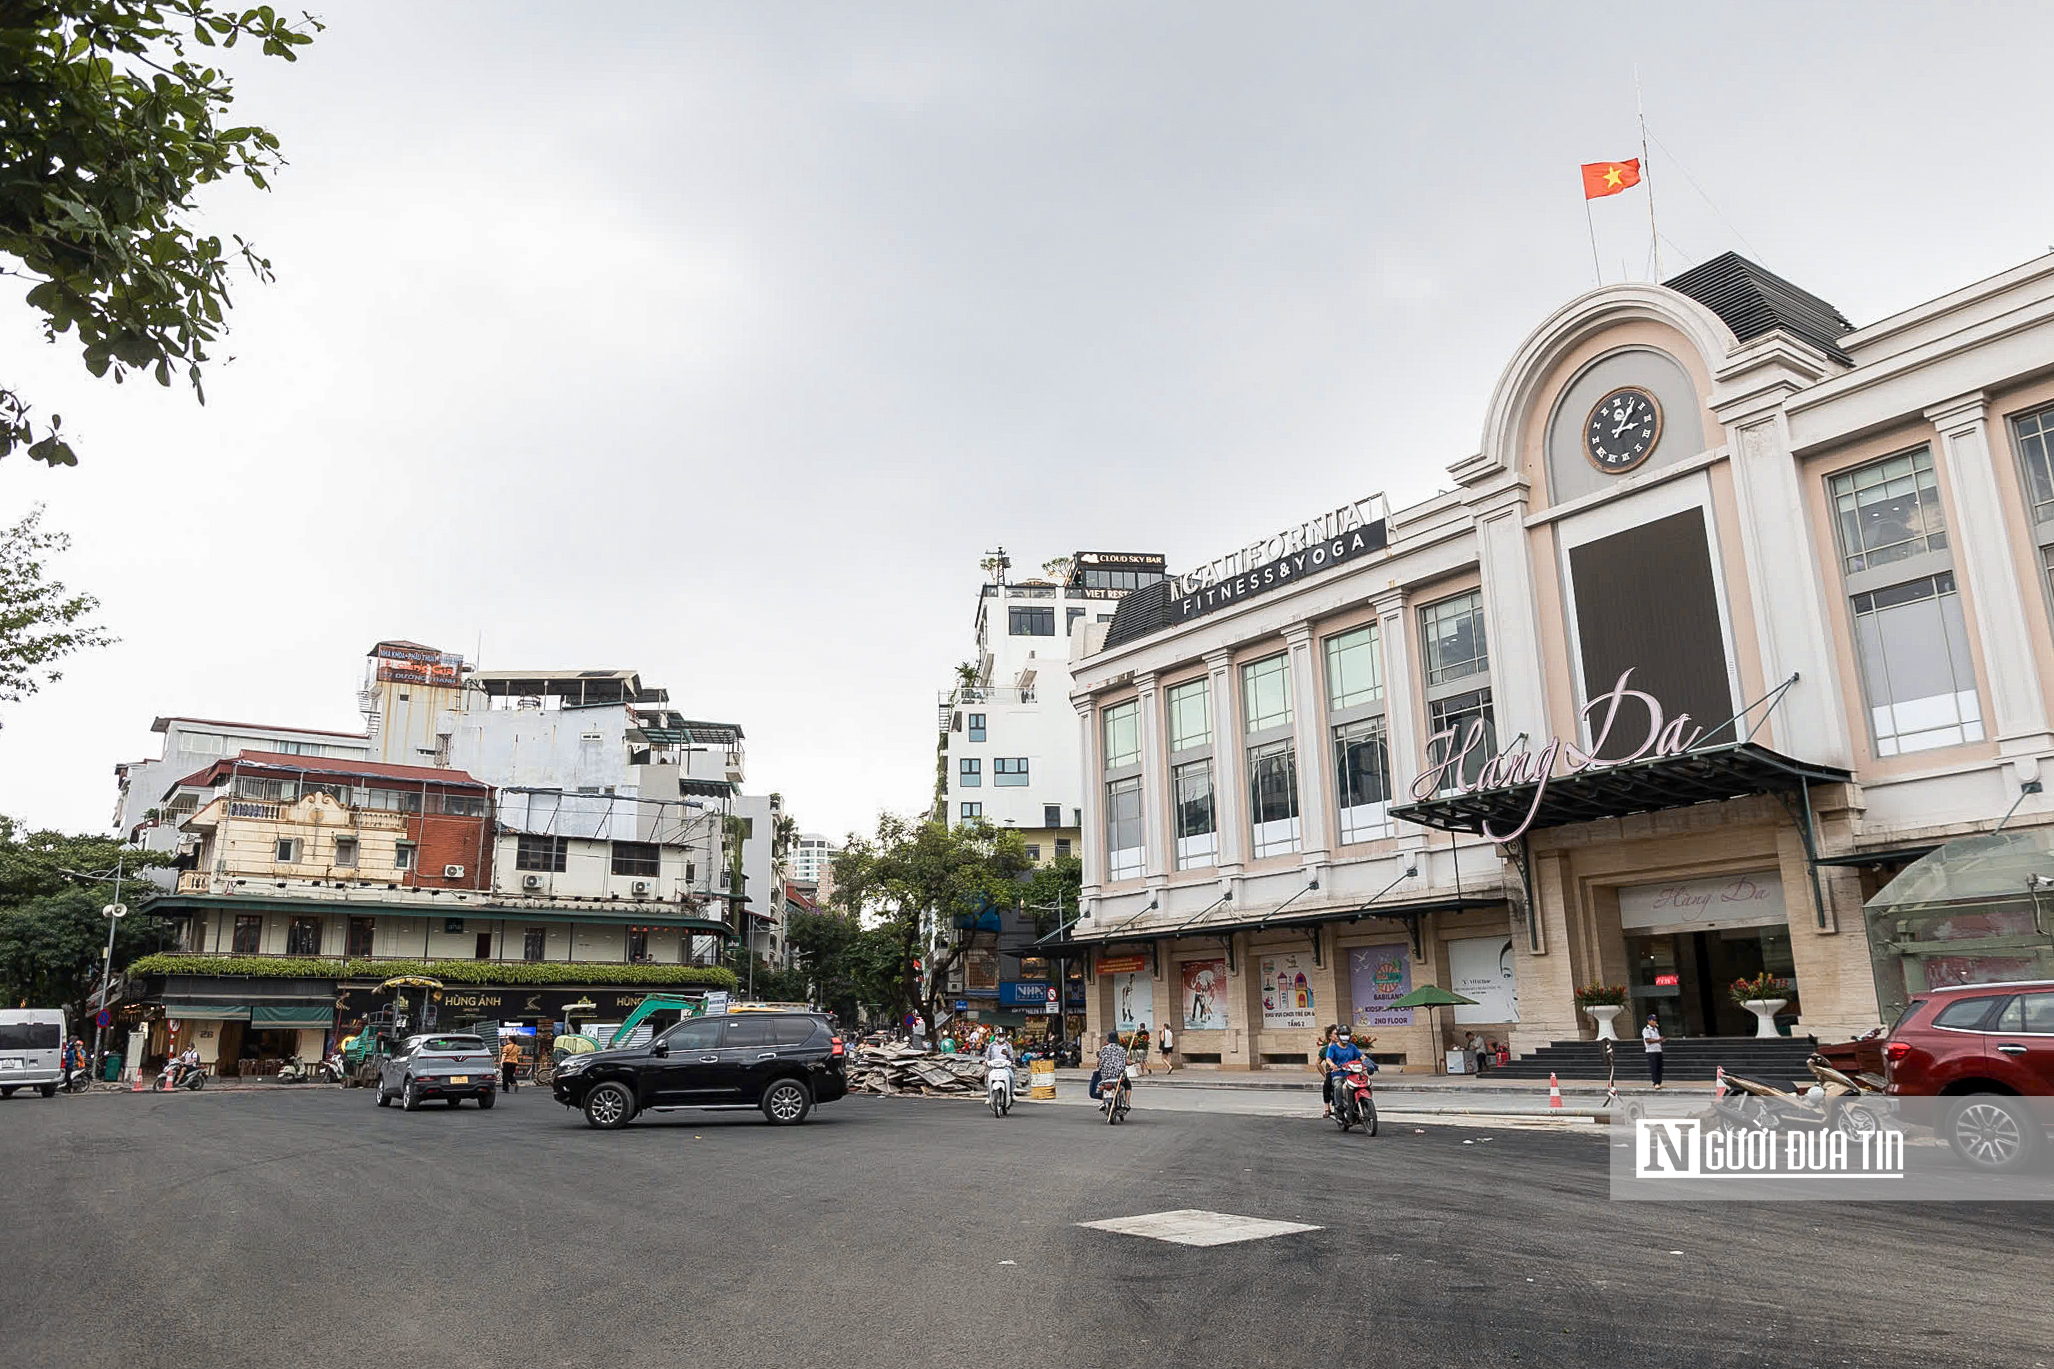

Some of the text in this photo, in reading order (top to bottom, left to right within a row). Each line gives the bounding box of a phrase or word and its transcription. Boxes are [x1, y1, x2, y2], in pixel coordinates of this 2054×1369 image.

[1181, 501, 1367, 596] CALIFORNIA
[1100, 555, 1127, 563] CLOUD
[1146, 556, 1161, 564] BAR
[1085, 589, 1105, 598] VIET
[1564, 667, 1702, 773] Da
[1721, 874, 1770, 902] Da
[445, 994, 501, 1006] HÙNG ÁNH
